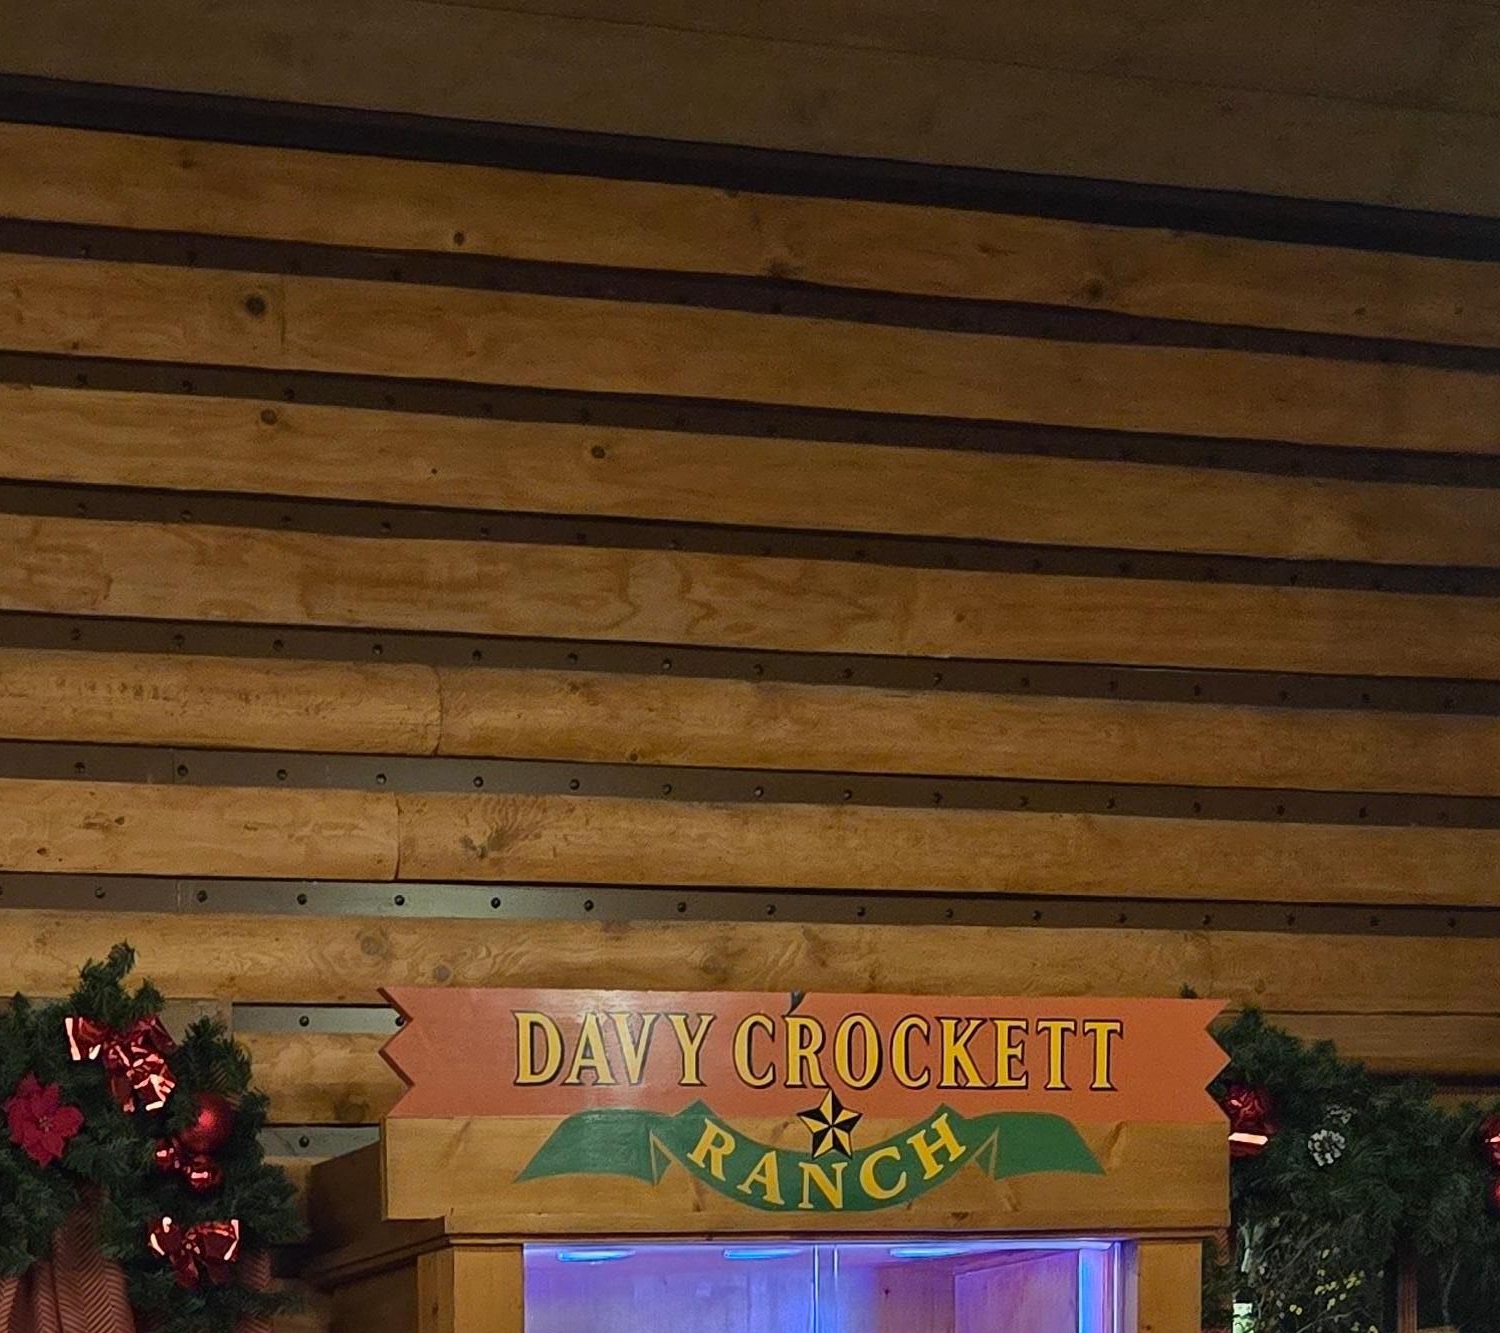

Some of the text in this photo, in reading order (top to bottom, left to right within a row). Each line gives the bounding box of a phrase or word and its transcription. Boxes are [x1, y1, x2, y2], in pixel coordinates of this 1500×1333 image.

[513, 1010, 1124, 1091] DAVY CROCKETT
[686, 1112, 967, 1210] RANCH
